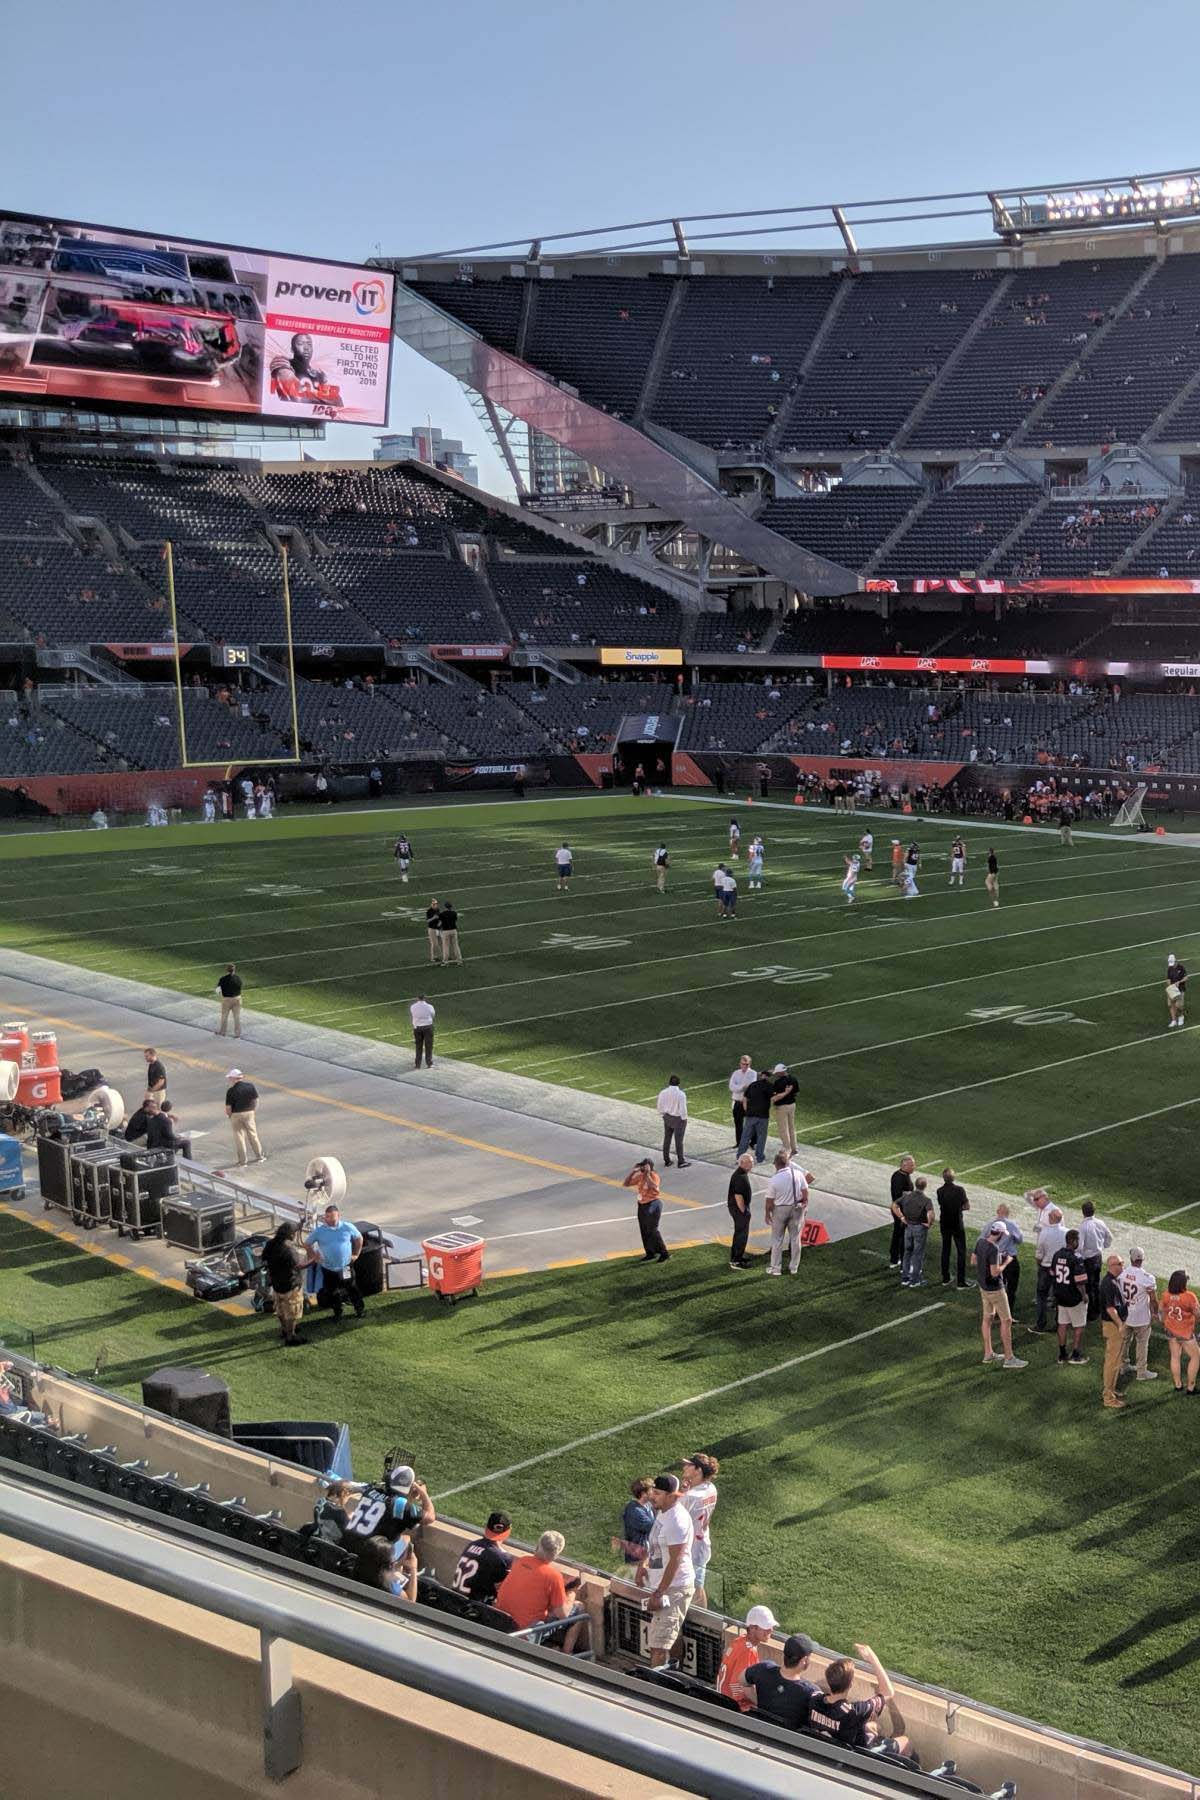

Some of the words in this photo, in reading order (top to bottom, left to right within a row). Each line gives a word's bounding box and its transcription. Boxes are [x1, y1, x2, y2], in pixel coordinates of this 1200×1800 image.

[275, 280, 351, 303] proven
[361, 288, 378, 306] IT
[340, 343, 379, 354] SELECTED
[353, 352, 363, 361] TO
[365, 354, 378, 362] HIS
[336, 360, 360, 368] FIRST
[361, 361, 378, 370] PRO
[343, 367, 367, 376] BOWL
[369, 369, 377, 377] IN
[227, 649, 246, 663] 34
[625, 651, 659, 662] Snapple
[1164, 667, 1198, 677] Regular
[731, 965, 833, 985] 50
[963, 1005, 1076, 1026] 40
[32, 1083, 47, 1098] G
[801, 1223, 819, 1243] 30
[430, 1256, 444, 1280] G
[1055, 1265, 1070, 1284] 52
[1123, 1282, 1138, 1300] 52
[1168, 1306, 1183, 1321] 23
[346, 1496, 386, 1535] 59
[452, 1556, 479, 1593] 52
[810, 1709, 840, 1731] TRUBISKY
